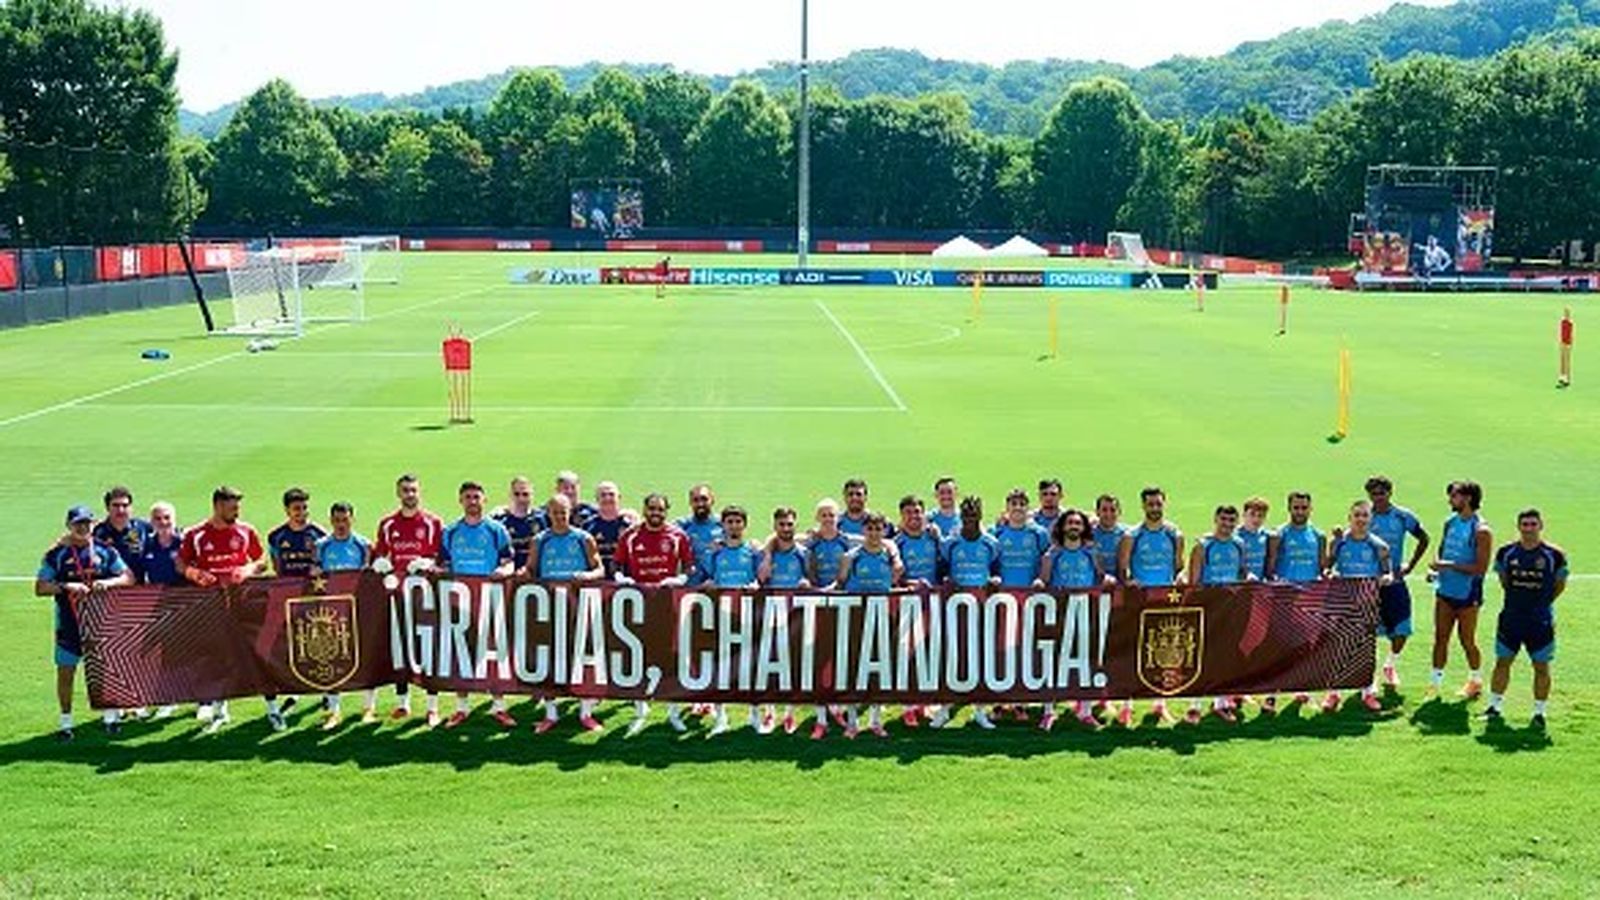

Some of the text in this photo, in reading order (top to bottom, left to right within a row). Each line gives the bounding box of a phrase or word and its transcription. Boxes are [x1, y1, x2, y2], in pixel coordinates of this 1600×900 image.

[549, 270, 593, 285] Dove
[690, 269, 780, 285] Hisense
[893, 270, 934, 286] VISA
[384, 574, 1112, 695] ¡GRACIAS, CHATTANOOGA!
